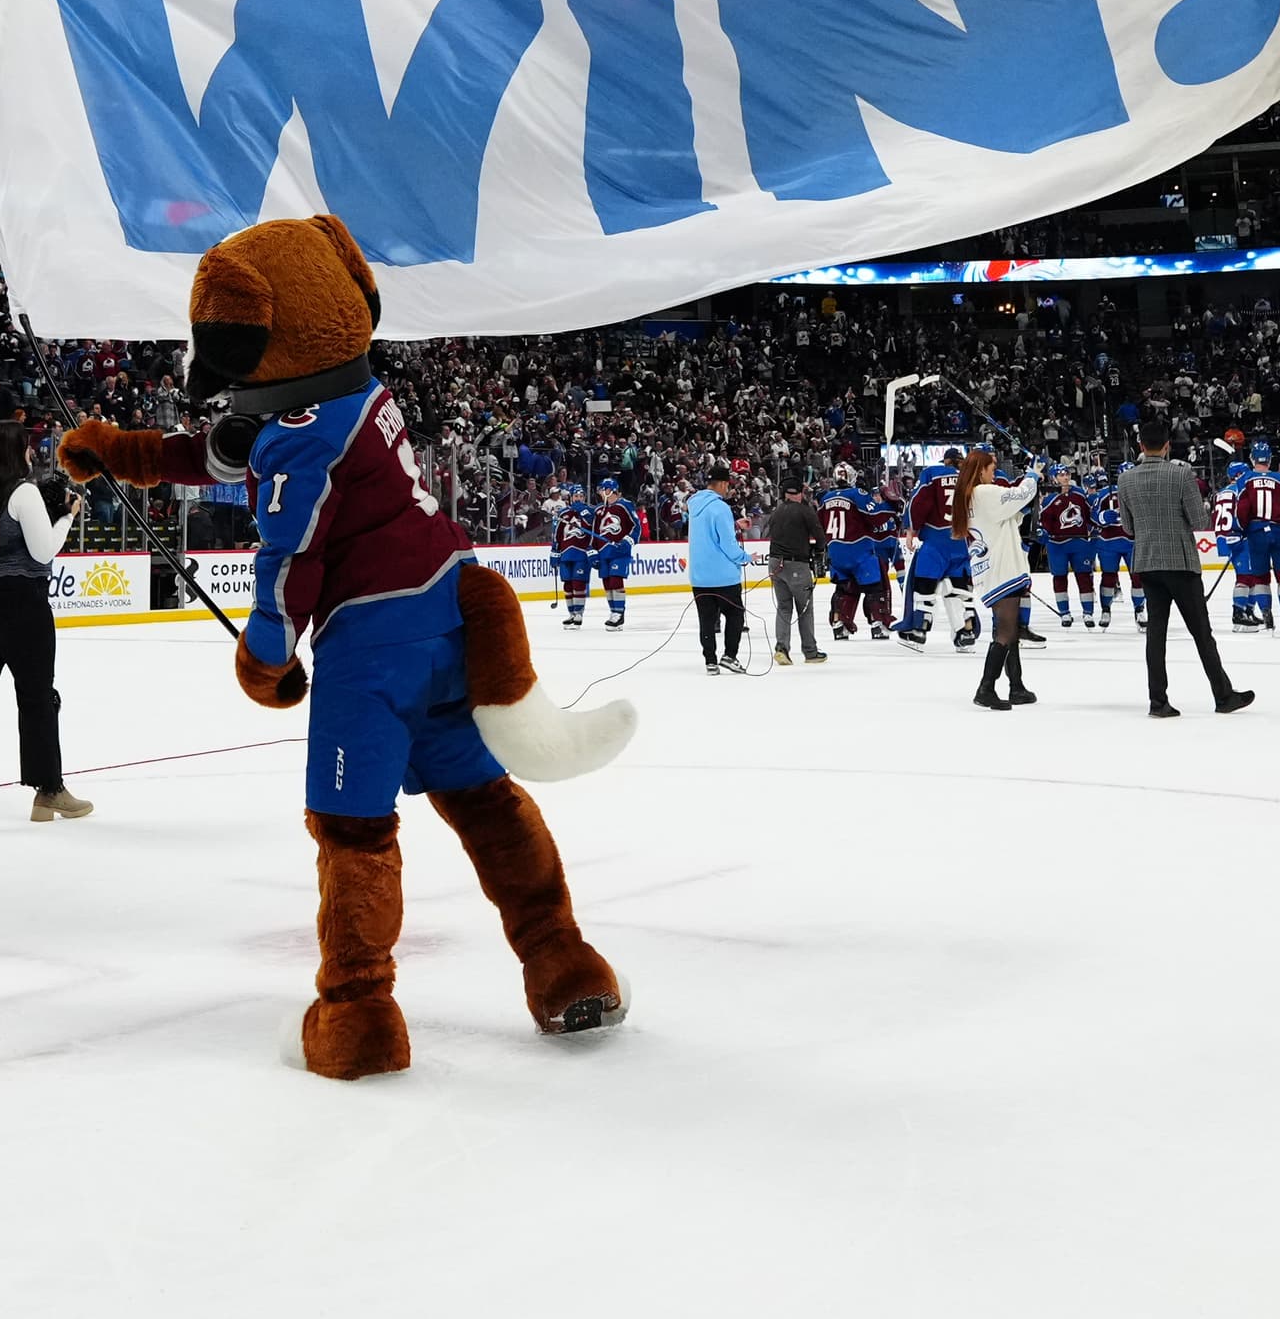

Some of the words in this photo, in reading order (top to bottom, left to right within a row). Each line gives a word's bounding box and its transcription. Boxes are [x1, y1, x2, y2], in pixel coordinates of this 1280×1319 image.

[1256, 490, 1272, 520] 11
[826, 510, 846, 540] 41
[1215, 503, 1233, 532] 25
[211, 564, 255, 577] COPPE
[488, 560, 507, 578] NEW
[211, 582, 256, 593] MOUN
[63, 598, 103, 611] LEMONADES
[108, 597, 132, 608] VODKA
[335, 747, 345, 792] CCM
